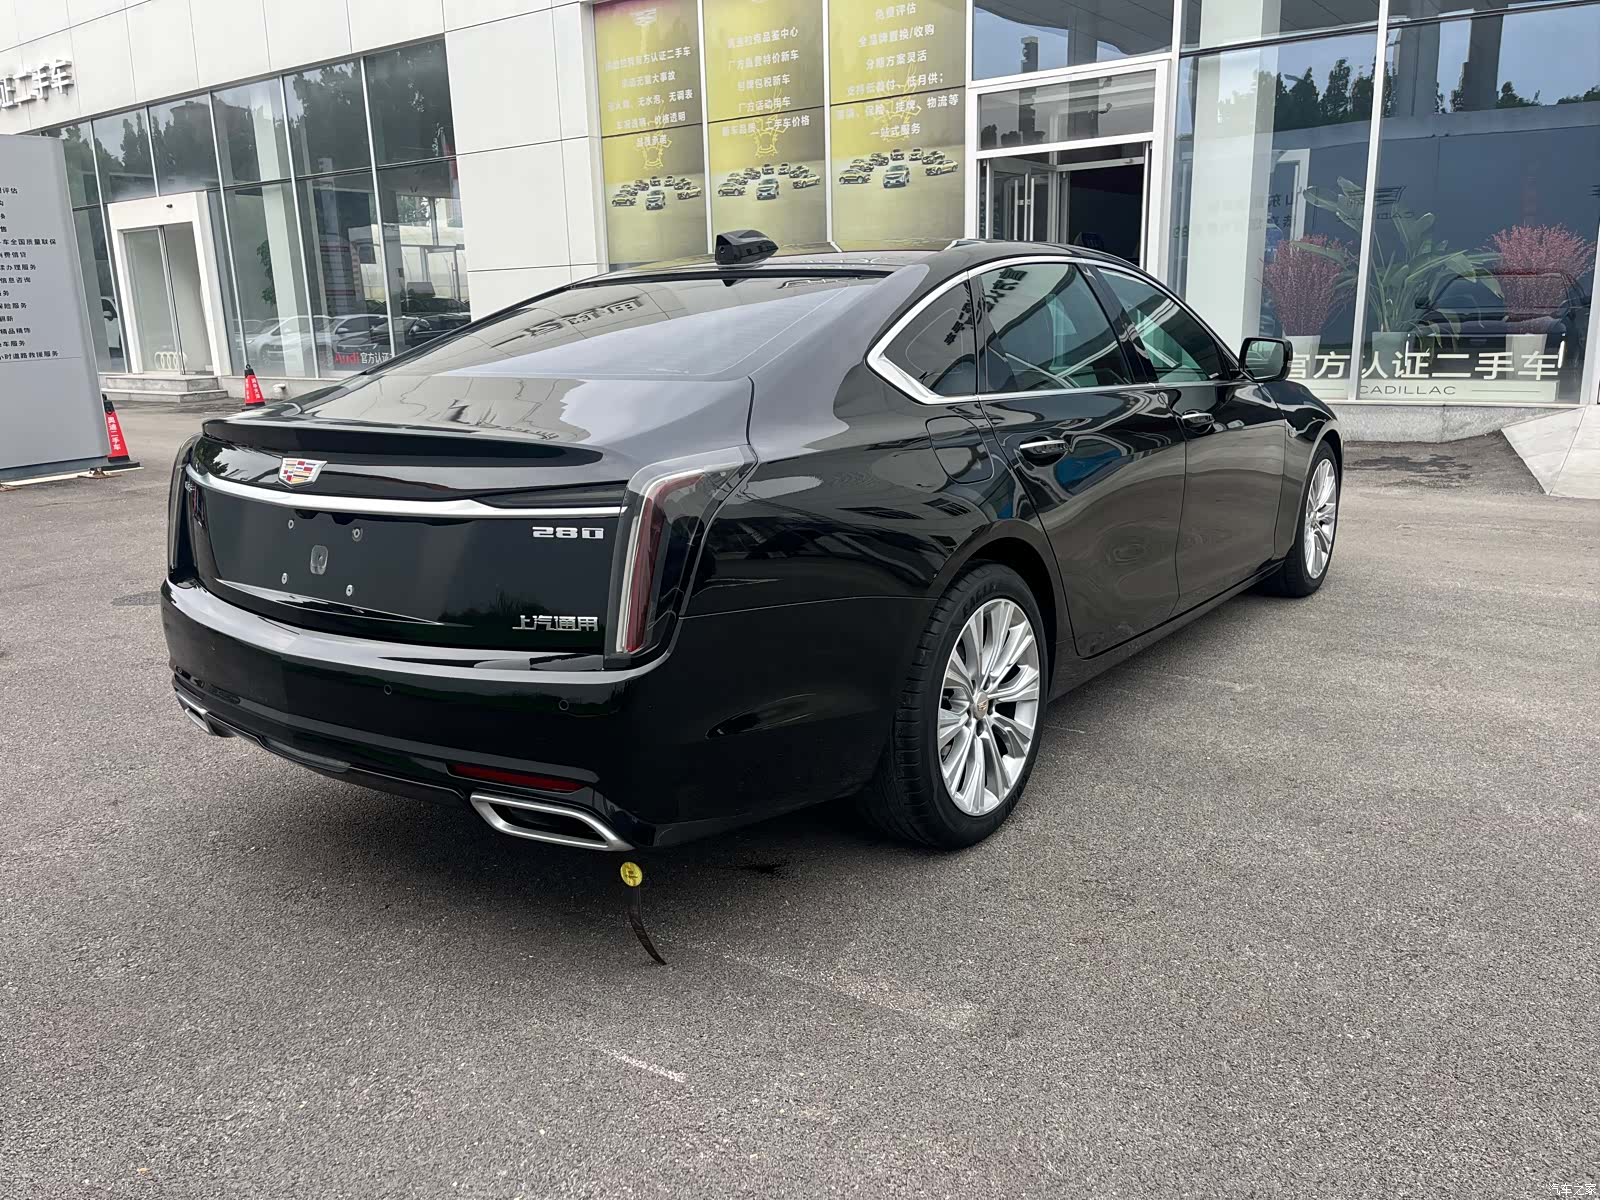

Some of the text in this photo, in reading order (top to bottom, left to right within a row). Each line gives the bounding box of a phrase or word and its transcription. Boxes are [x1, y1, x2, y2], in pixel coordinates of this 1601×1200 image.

[361, 352, 393, 364] 官方认证
[1360, 385, 1456, 395] CADILLAC
[512, 615, 598, 631] 上汽通用
